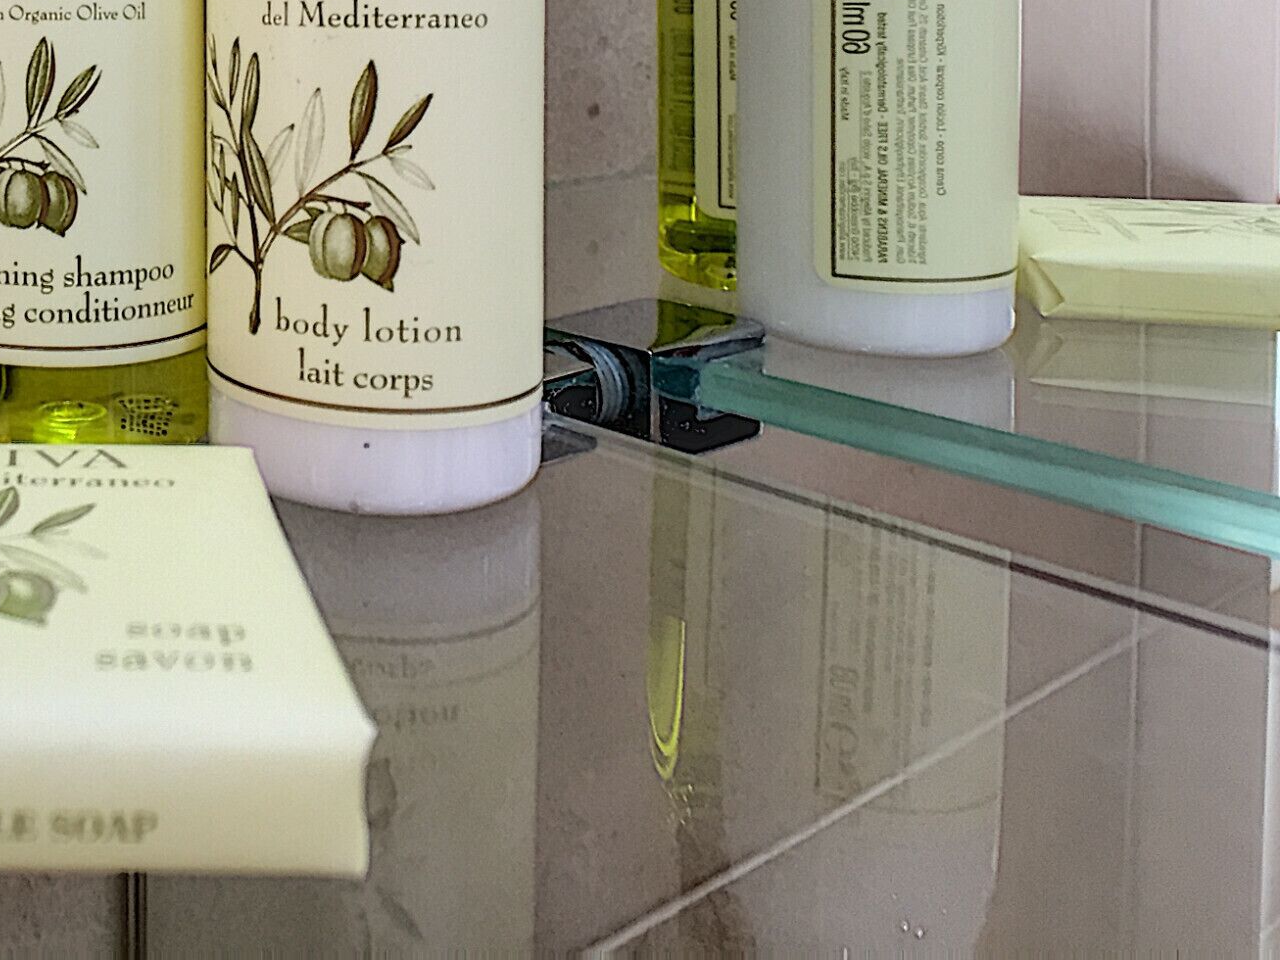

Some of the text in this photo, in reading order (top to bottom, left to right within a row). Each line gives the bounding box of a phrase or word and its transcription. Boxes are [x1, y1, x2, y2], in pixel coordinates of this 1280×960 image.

[8, 4, 72, 23] Organic
[76, 3, 118, 21] Olive
[123, 3, 146, 21] Oil
[261, 0, 288, 27] del
[63, 254, 174, 291] shampoo
[23, 290, 195, 324] conditionneur
[275, 296, 463, 347] body lotion
[298, 346, 434, 399] lait corps
[124, 621, 246, 648] soap
[94, 649, 253, 673] savon
[49, 807, 160, 844] SOAP
